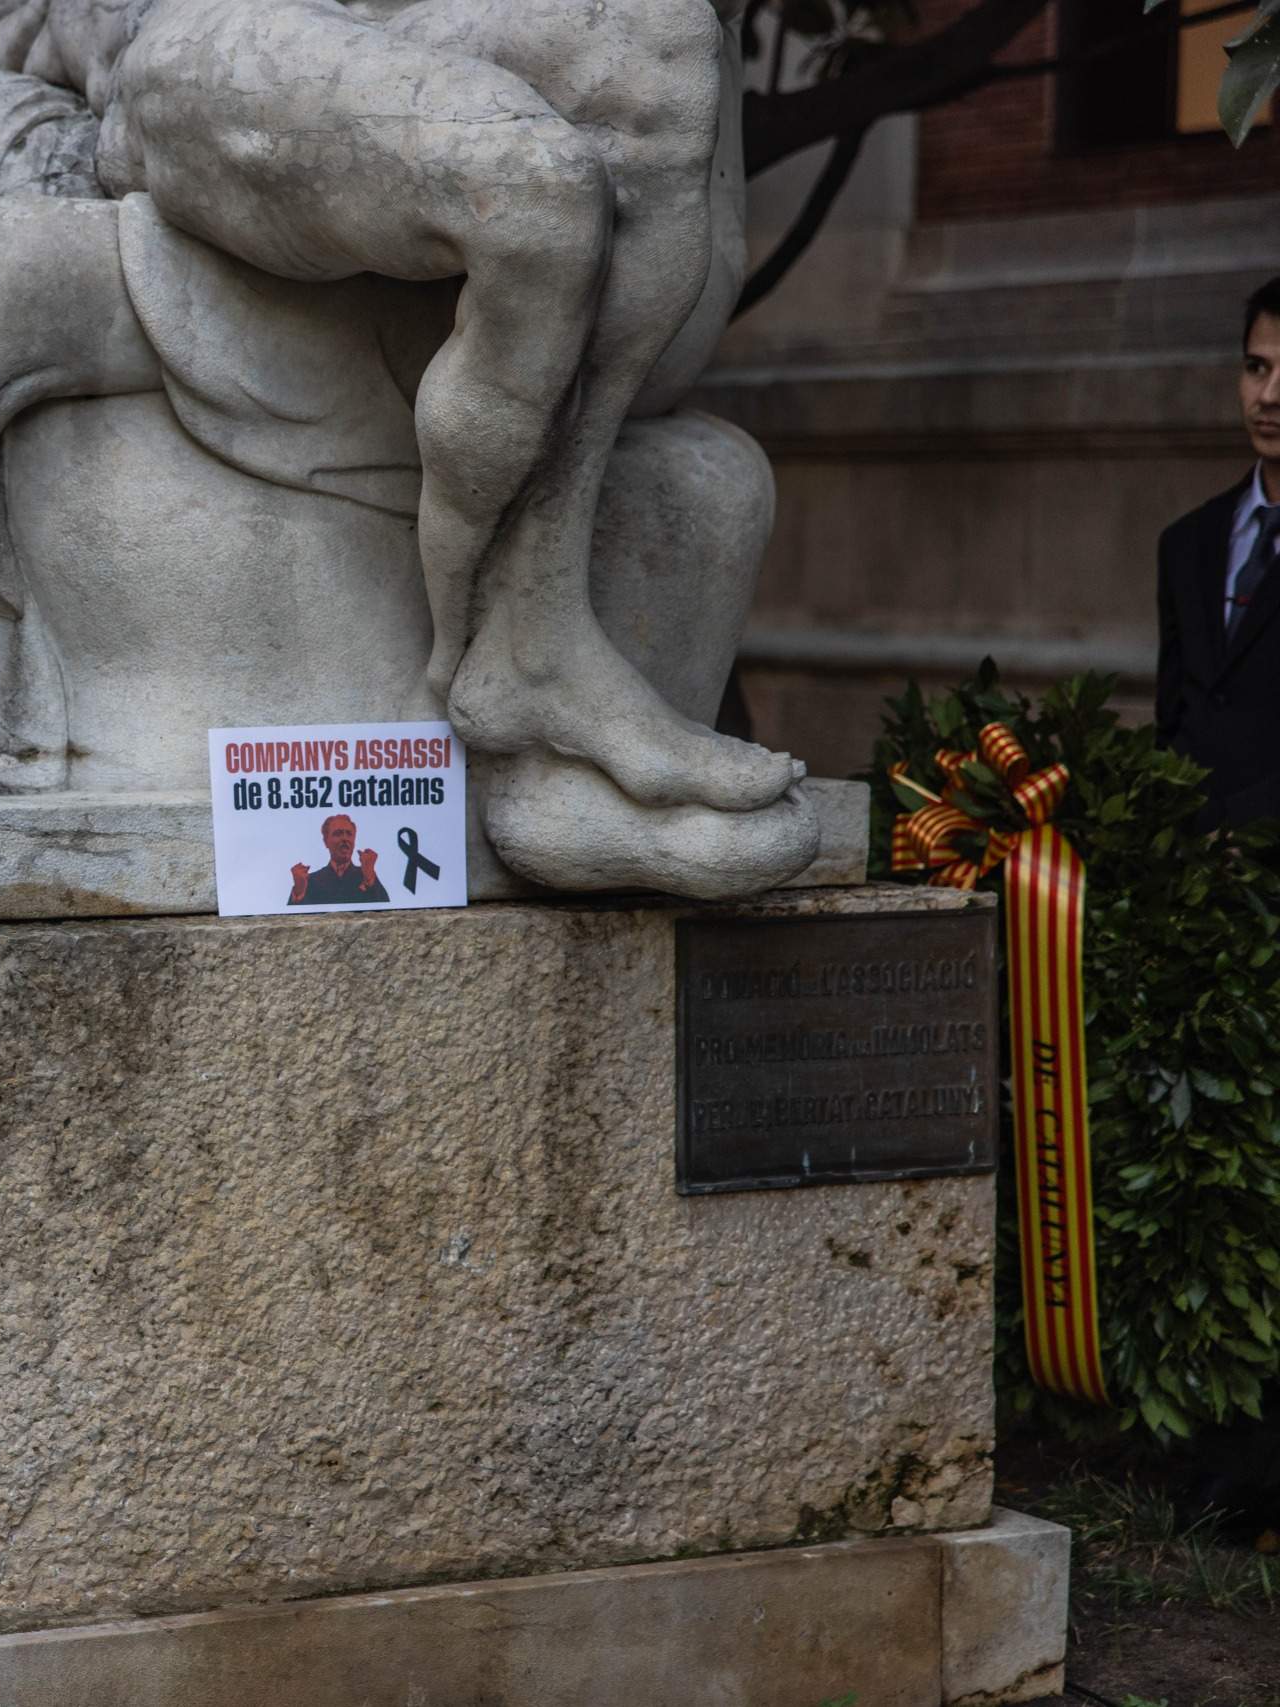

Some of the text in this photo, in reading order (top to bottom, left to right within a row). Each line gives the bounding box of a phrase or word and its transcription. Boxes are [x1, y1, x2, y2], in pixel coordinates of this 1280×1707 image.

[226, 736, 451, 773] COMPANYS ASSASSÍ
[233, 775, 444, 810] de 8.352 catalans
[1033, 1040, 1059, 1087] DE
